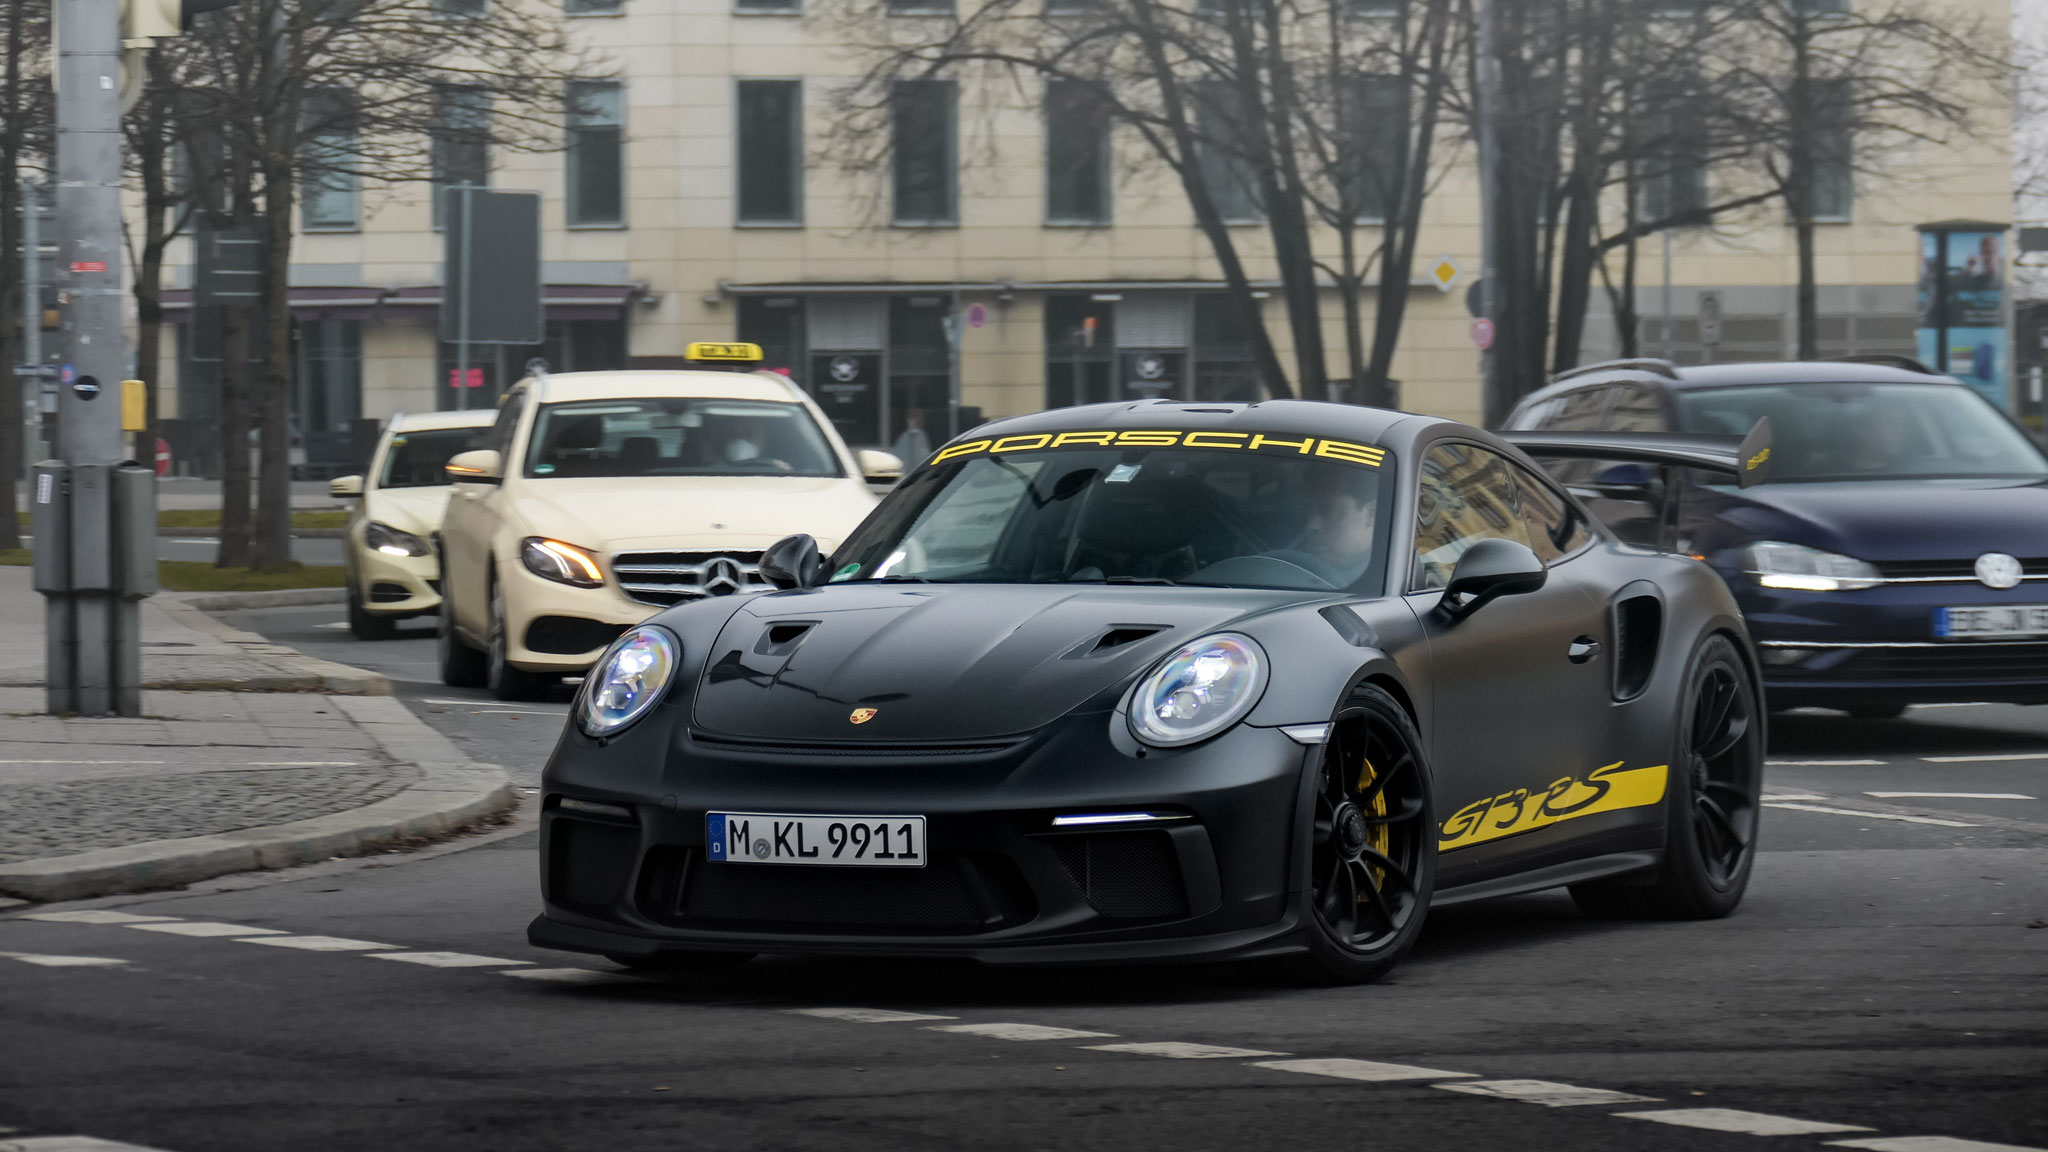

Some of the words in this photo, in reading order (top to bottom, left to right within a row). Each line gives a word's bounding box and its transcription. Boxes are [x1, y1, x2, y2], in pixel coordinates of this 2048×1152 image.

[930, 431, 1386, 467] PORSCHE
[1438, 788, 1531, 842] GT3
[1532, 760, 1624, 822] RS
[713, 842, 721, 853] D
[729, 820, 750, 856] M
[773, 821, 819, 858] KL
[827, 822, 919, 859] 9911
